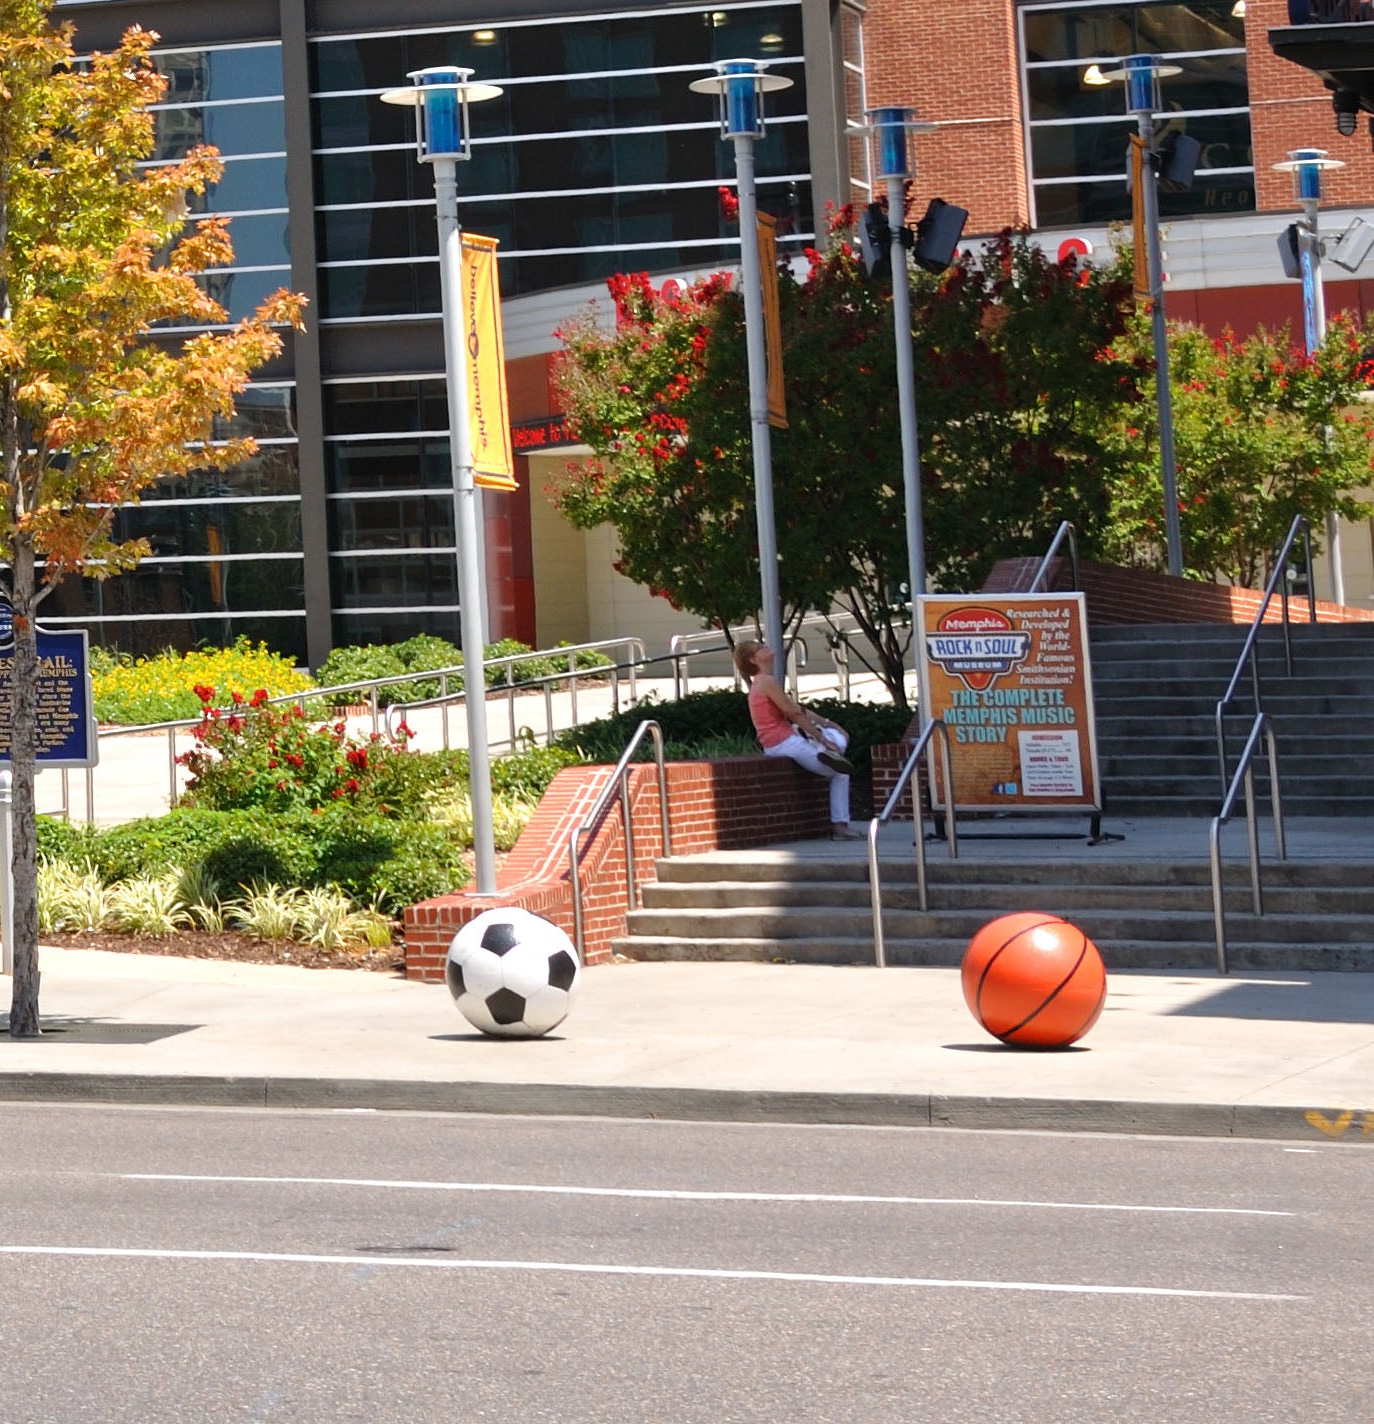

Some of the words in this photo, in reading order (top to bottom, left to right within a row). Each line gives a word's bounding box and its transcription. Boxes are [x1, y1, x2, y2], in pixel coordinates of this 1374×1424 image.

[1006, 607, 1060, 619] Researched
[1061, 609, 1071, 618] &
[945, 619, 1005, 633] Memphis
[1021, 619, 1069, 631] Developed
[1041, 630, 1053, 641] by
[1054, 630, 1070, 641] the
[936, 639, 972, 655] ROCK
[984, 639, 1018, 655] SOUL
[1040, 641, 1072, 651] World-
[37, 655, 73, 668] AIL:
[1036, 653, 1075, 662] Famous
[953, 661, 1002, 669] MUSEUM
[1015, 663, 1076, 674] Smithsonian
[40, 667, 78, 678] EMPHIS
[951, 690, 979, 706] THE
[983, 688, 1065, 706] COMPLETE
[943, 707, 1018, 725] MEMPHIS
[1021, 706, 1076, 725] MUSIC
[956, 726, 1007, 743] STORY
